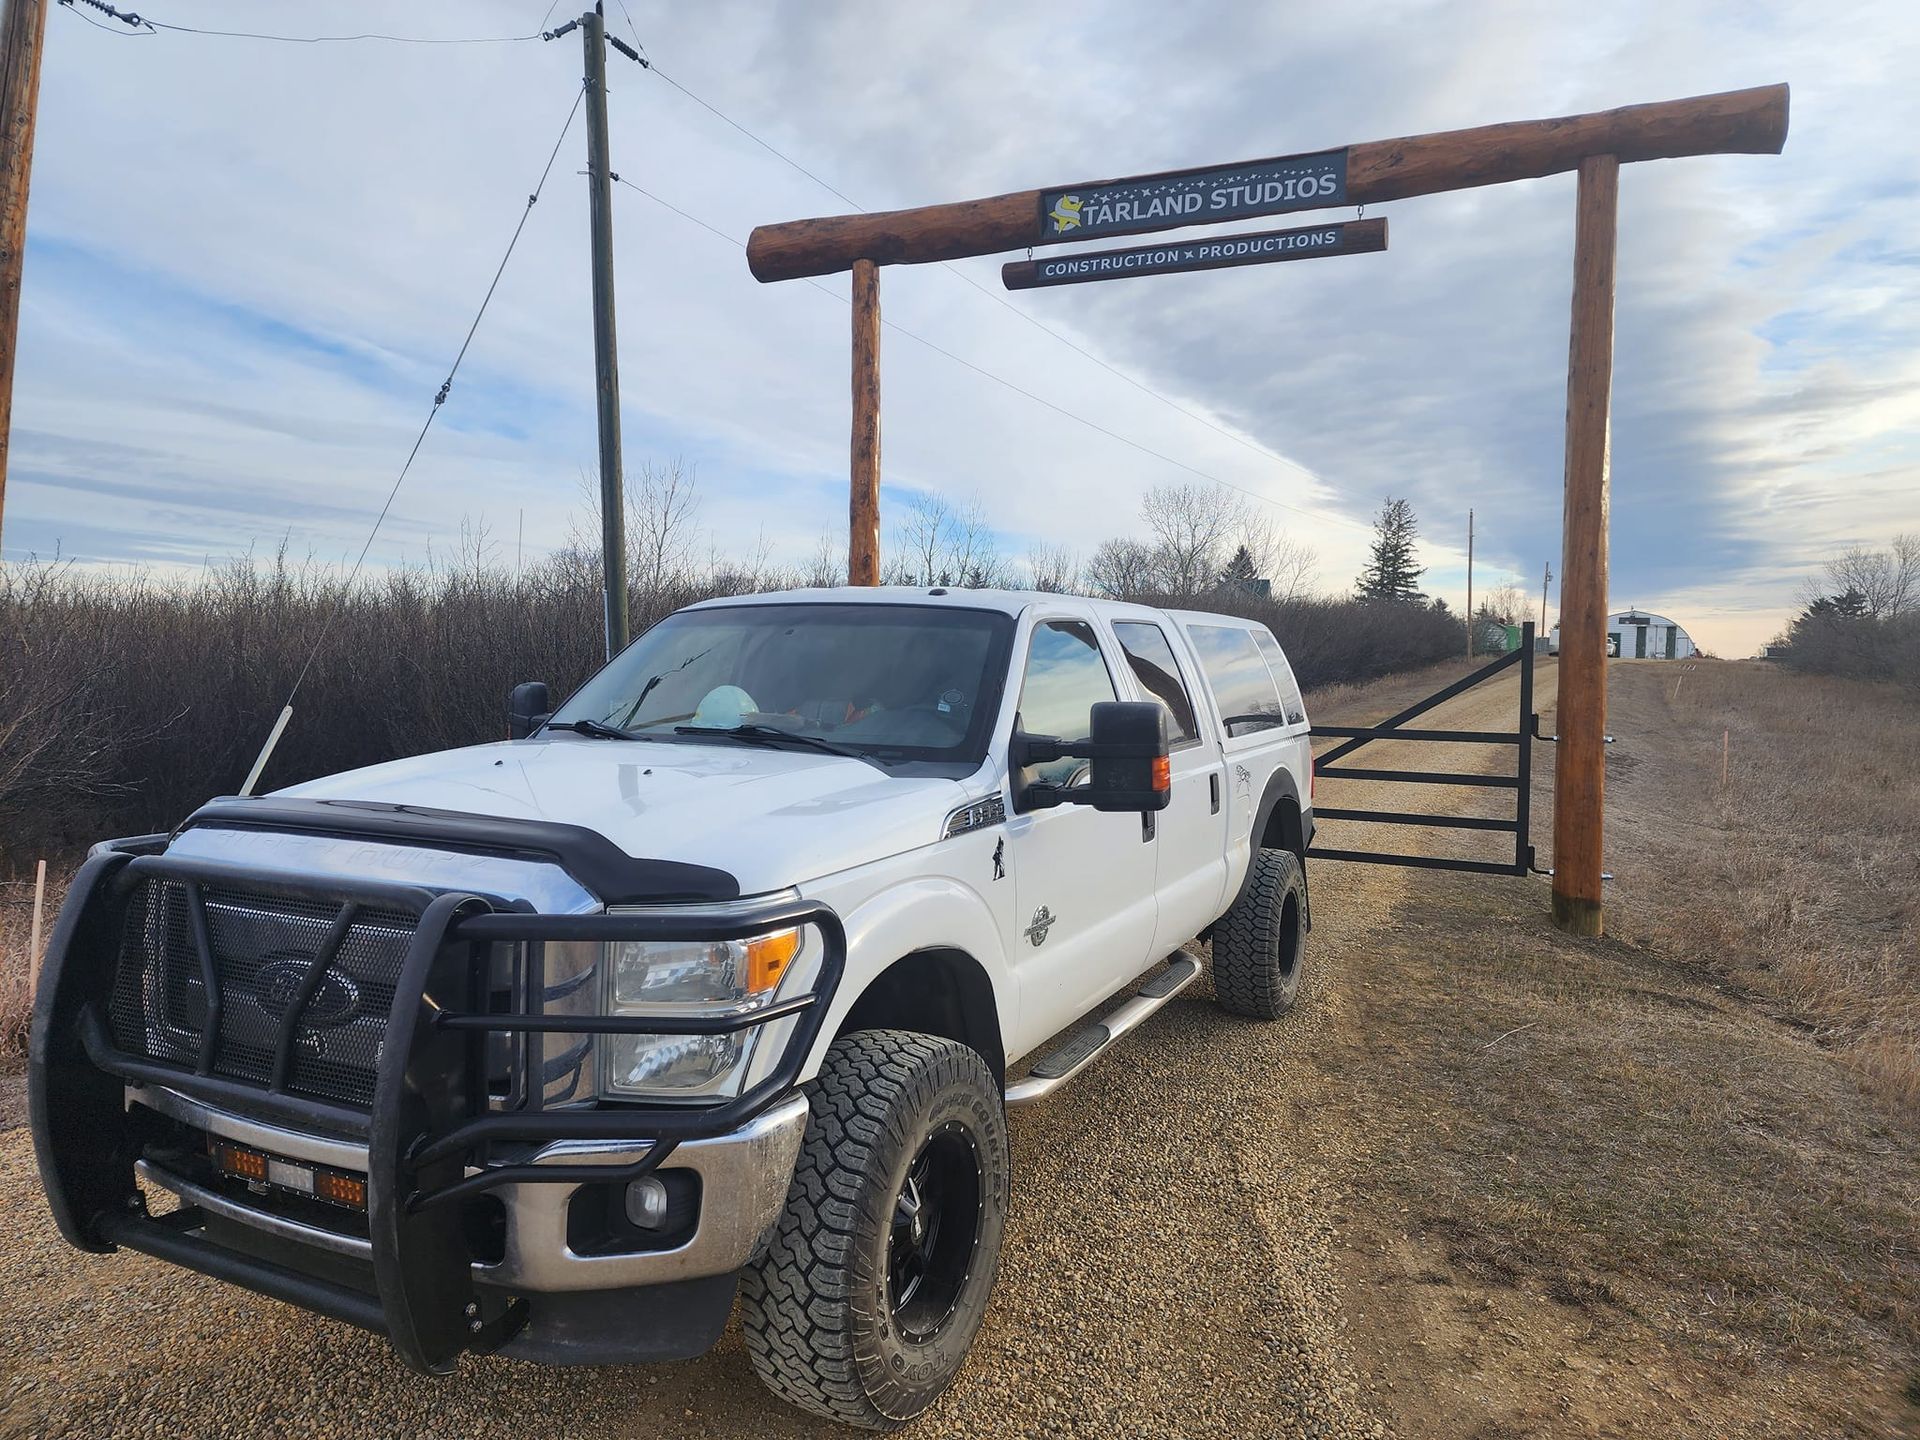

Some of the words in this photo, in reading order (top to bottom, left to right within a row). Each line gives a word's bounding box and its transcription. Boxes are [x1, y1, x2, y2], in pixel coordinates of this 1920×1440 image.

[1053, 193, 1203, 232] STARLAND
[1210, 173, 1337, 210] STUDIOS
[1045, 250, 1179, 276] CONSTRUCTION
[1199, 231, 1336, 259] PRODUCTIONS
